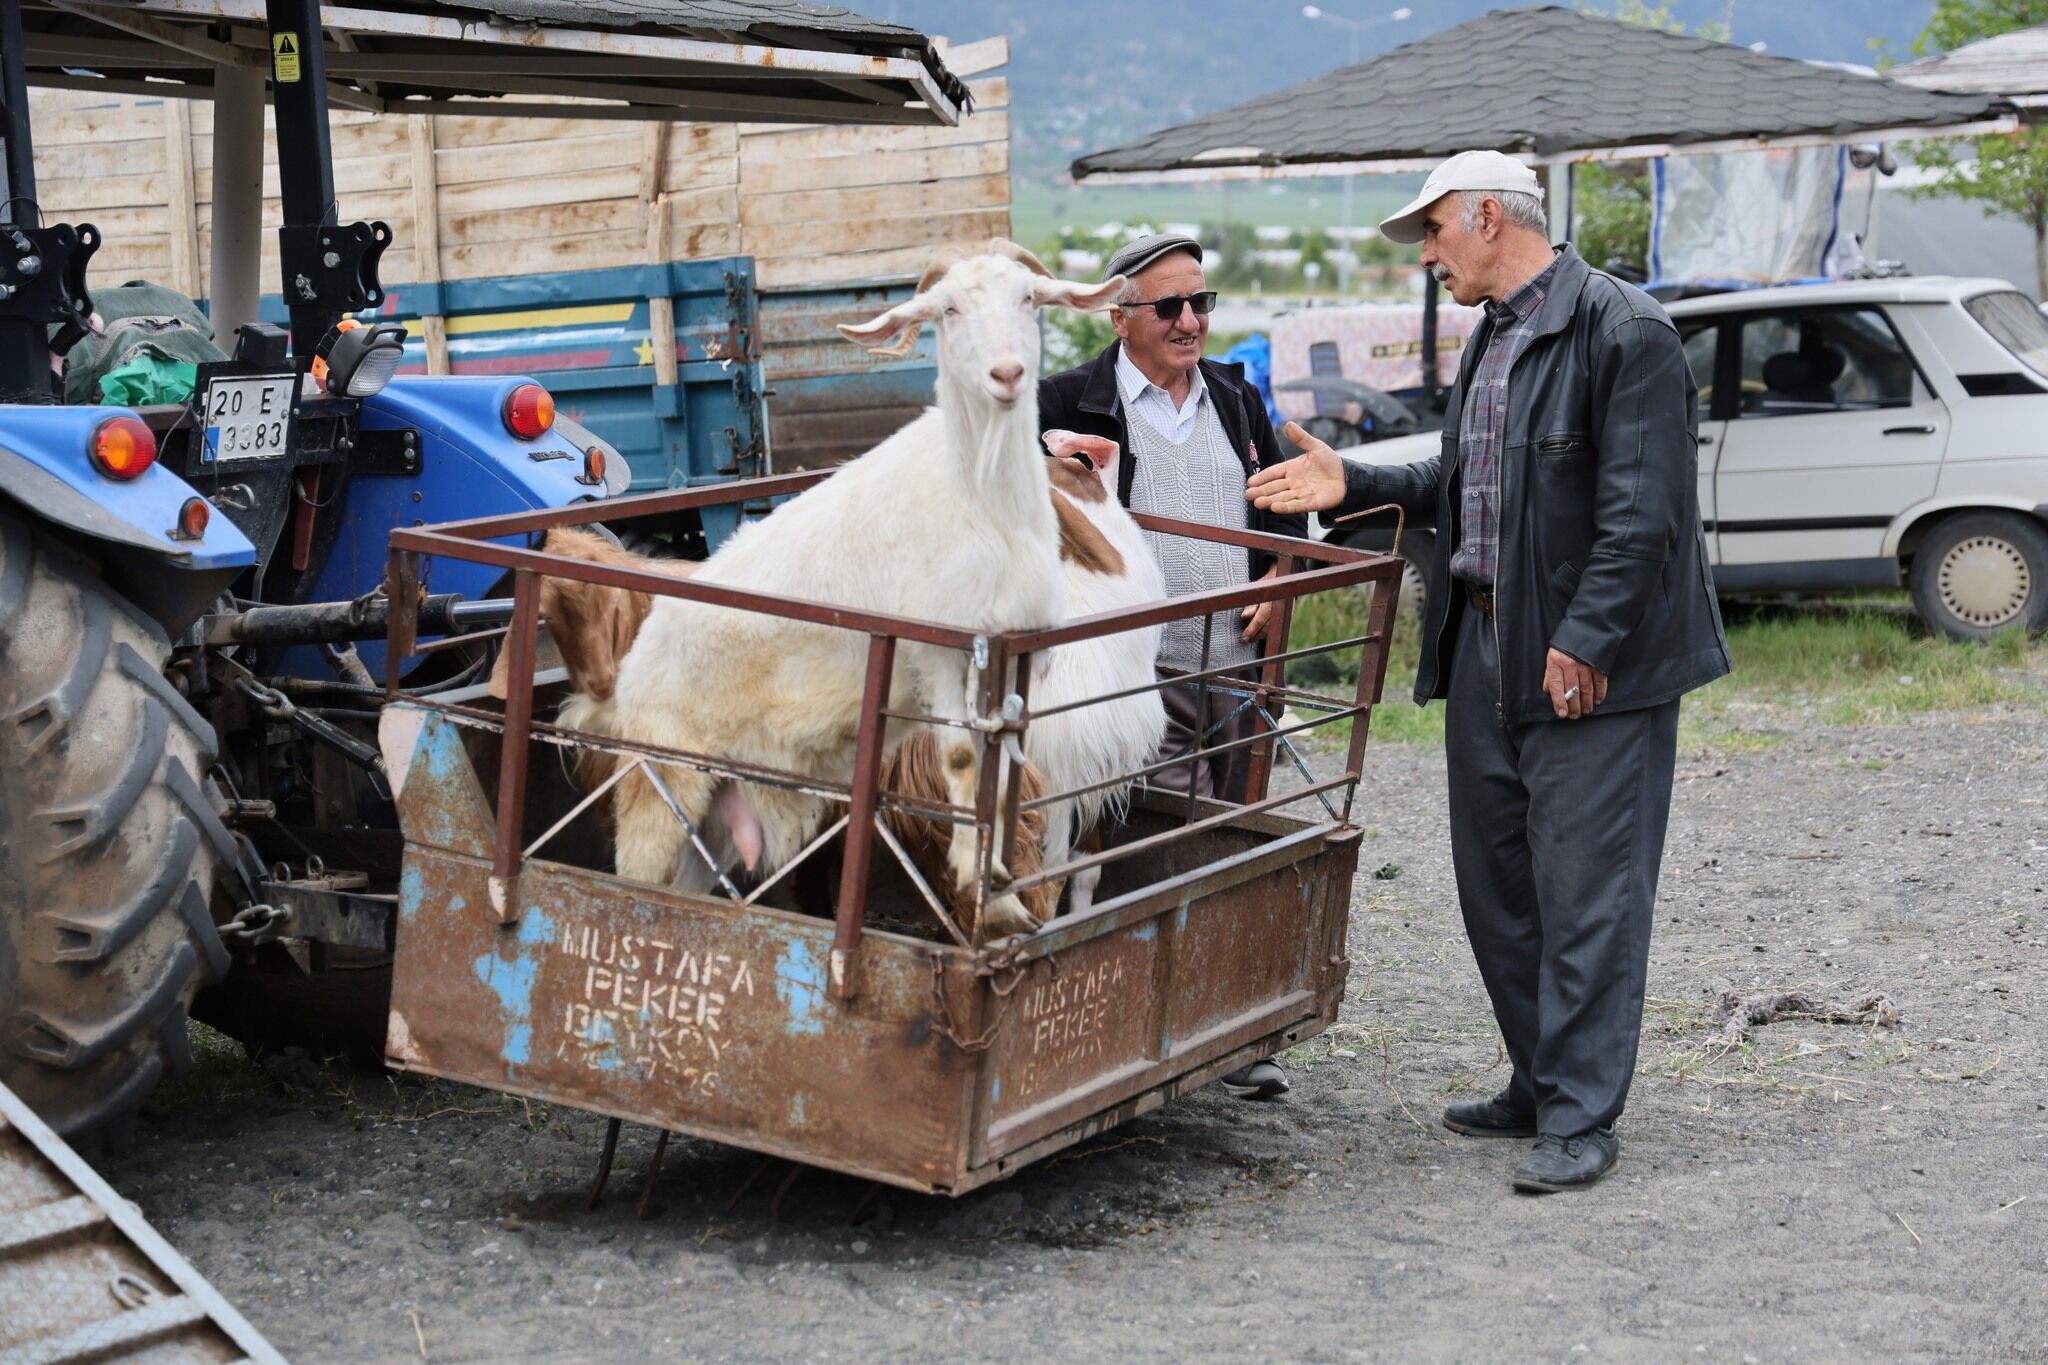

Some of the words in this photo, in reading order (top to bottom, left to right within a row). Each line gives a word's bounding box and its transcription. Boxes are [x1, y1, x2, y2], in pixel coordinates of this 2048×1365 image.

[214, 390, 243, 416] 20
[260, 386, 275, 414] E
[562, 922, 754, 997] MUSTAFA
[1023, 957, 1123, 1022] MUSTAFA
[584, 965, 726, 1032] PEKER
